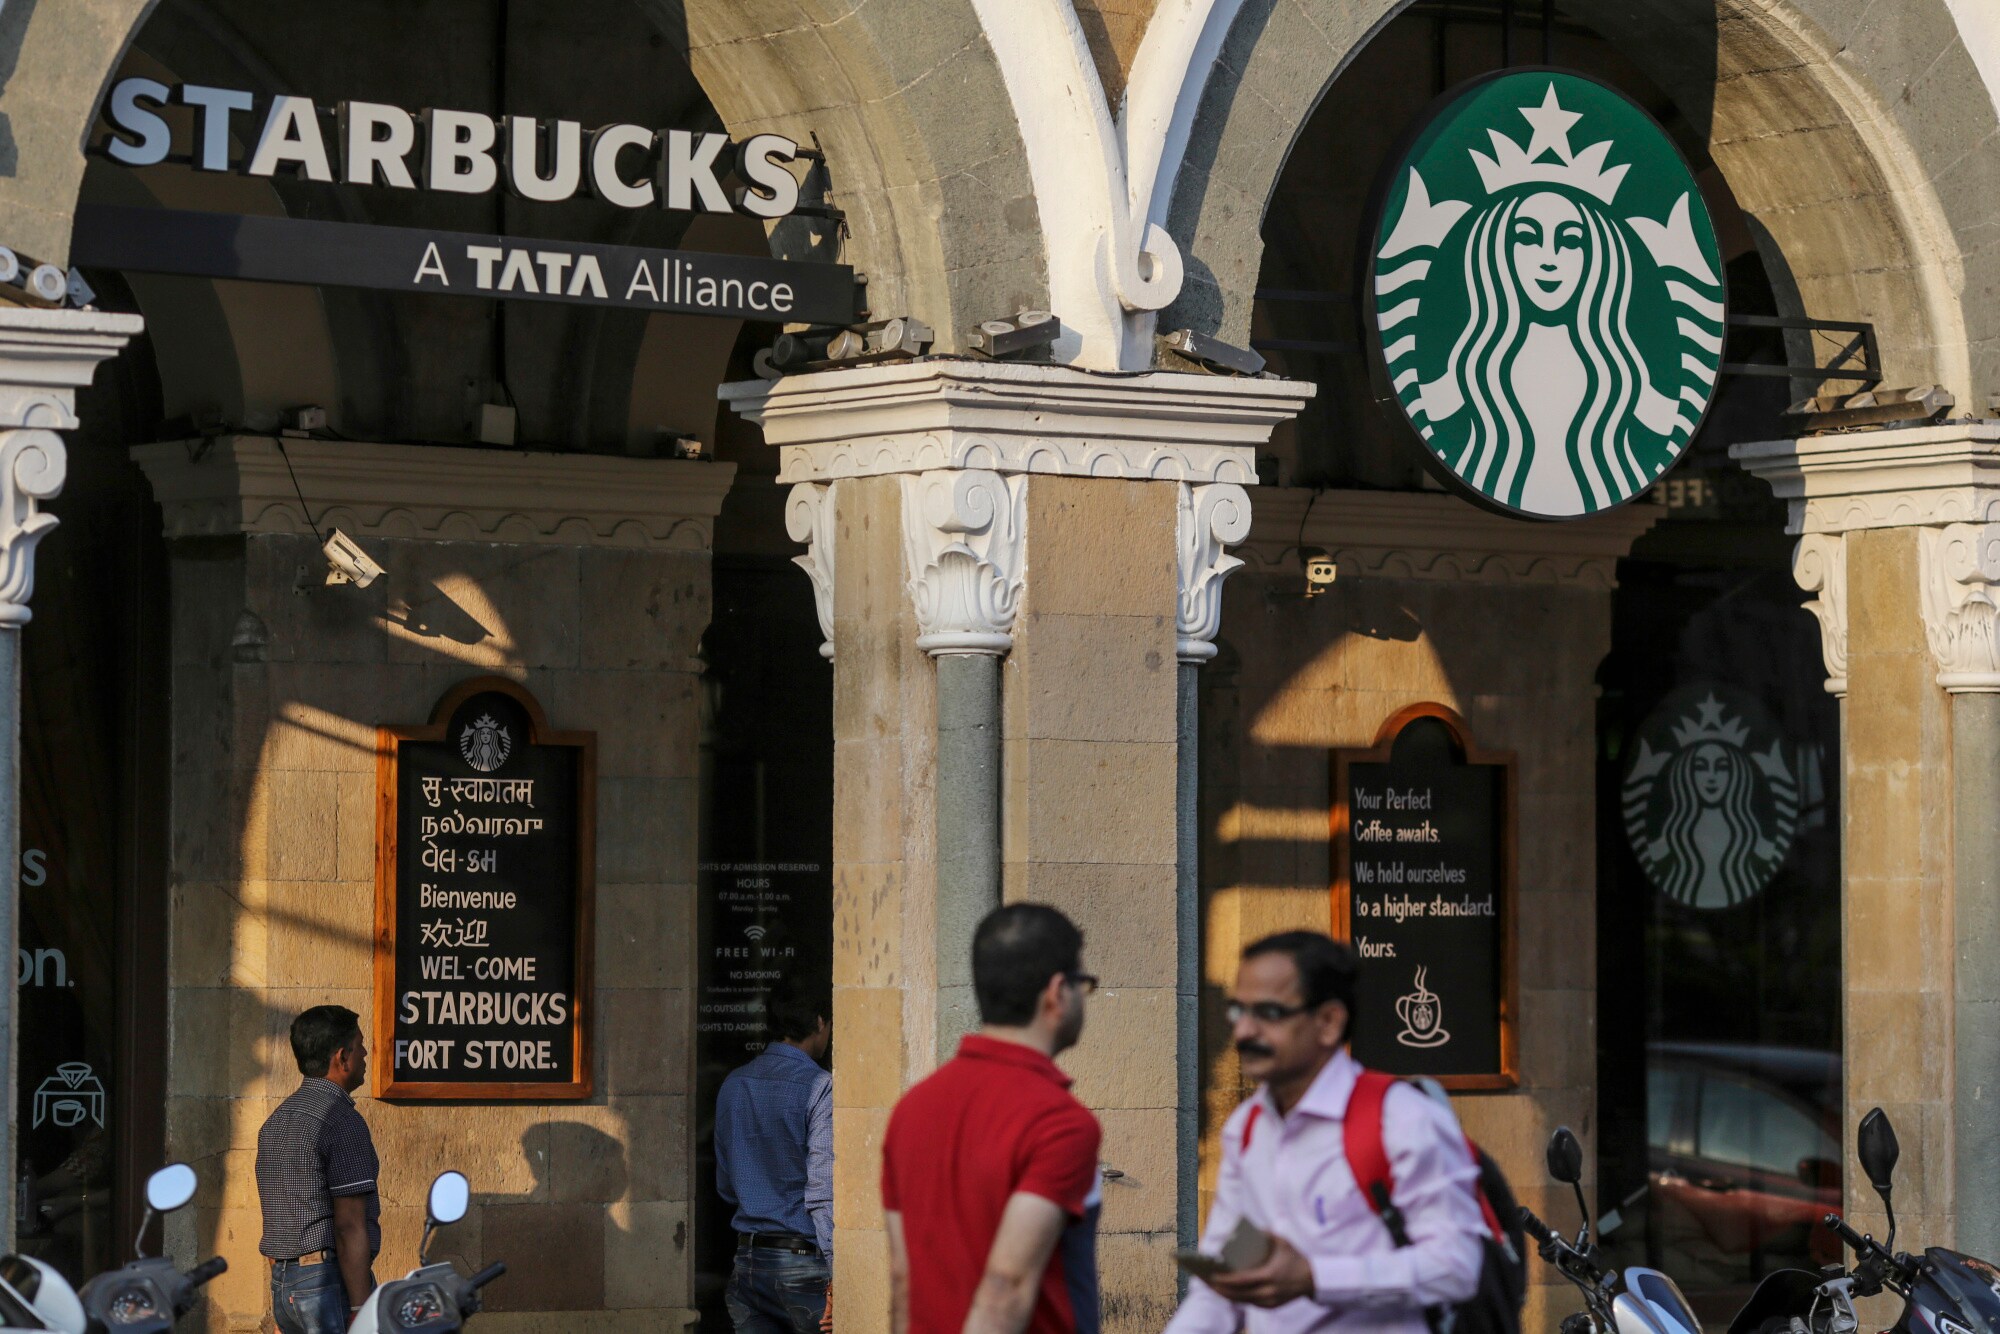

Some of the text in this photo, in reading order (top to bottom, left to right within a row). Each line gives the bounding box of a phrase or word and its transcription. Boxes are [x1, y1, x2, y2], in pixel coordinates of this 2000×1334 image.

[107, 77, 800, 218] STARBUCKS
[413, 242, 794, 313] A TATA Alliance
[1355, 787, 1432, 810] Your Perfect
[421, 809, 543, 841] நல்வரவு
[1354, 819, 1441, 843] Coffee awaits.
[720, 863, 732, 872] OF
[733, 863, 776, 872] ADMISSION
[778, 863, 820, 872] RESERVED
[1355, 862, 1466, 884] We hold ourselves
[737, 878, 770, 889] HOURS
[420, 883, 517, 909] Bienvenue
[1355, 893, 1496, 923] to a higher standard.
[420, 917, 490, 948] 欢迎
[716, 947, 749, 958] FREE
[1356, 935, 1397, 958] Yours.
[420, 956, 536, 981] WEL-COME
[730, 970, 781, 980] NO SMOKING
[399, 991, 567, 1026] STARBUCKS
[699, 1004, 712, 1013] NO
[713, 1004, 746, 1013] OUTSIDE
[723, 1023, 734, 1031] TO
[395, 1039, 558, 1070] FORT STORE.
[745, 1042, 766, 1051] CCTV
